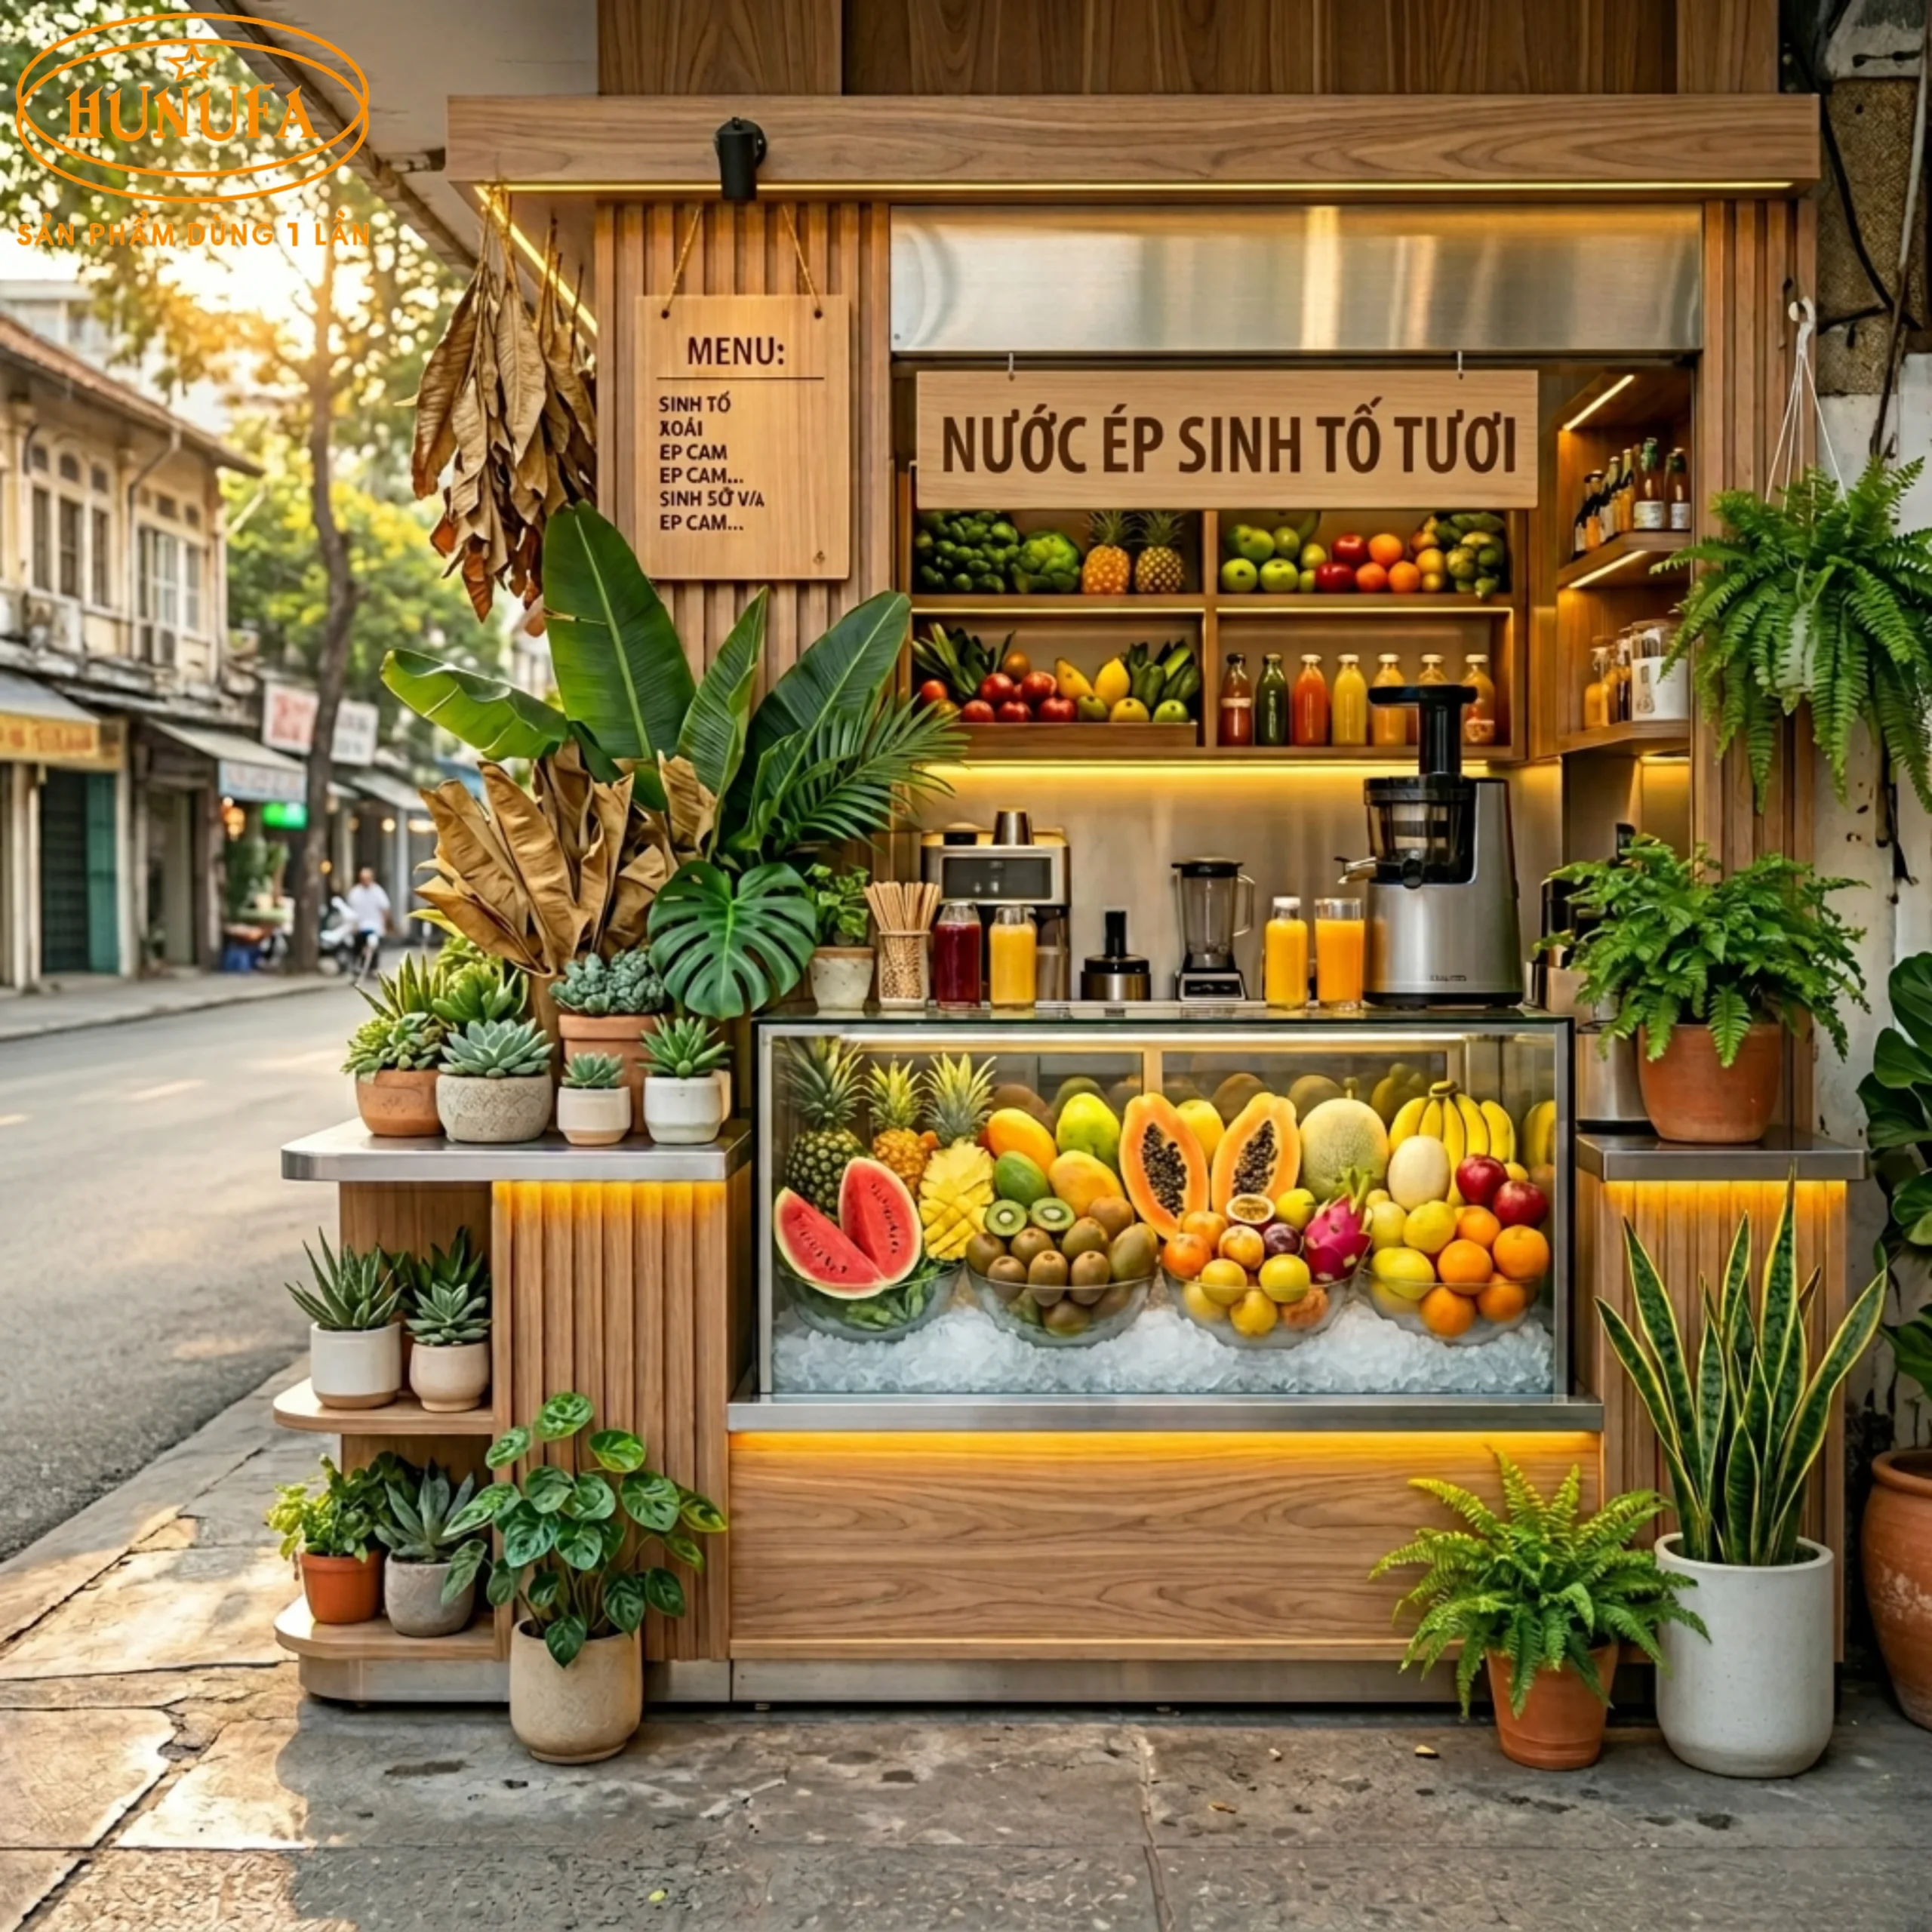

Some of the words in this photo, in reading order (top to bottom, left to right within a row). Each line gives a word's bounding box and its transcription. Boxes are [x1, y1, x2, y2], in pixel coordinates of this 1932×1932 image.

[688, 337, 784, 365] MENU:
[658, 396, 702, 413] SINH
[706, 390, 731, 414] TỐ
[943, 403, 1088, 474] NƯỚC
[1103, 403, 1164, 473] ÉP
[1178, 416, 1301, 474] SINH
[1315, 396, 1383, 474] TỐ
[1393, 408, 1517, 474] TƯƠI
[660, 444, 683, 460] EP
[686, 444, 728, 461] CAM
[660, 467, 683, 484] EP
[686, 467, 744, 484] CAM...
[659, 491, 703, 507] SINH
[660, 515, 682, 531] EP
[686, 515, 744, 531] CAM...
